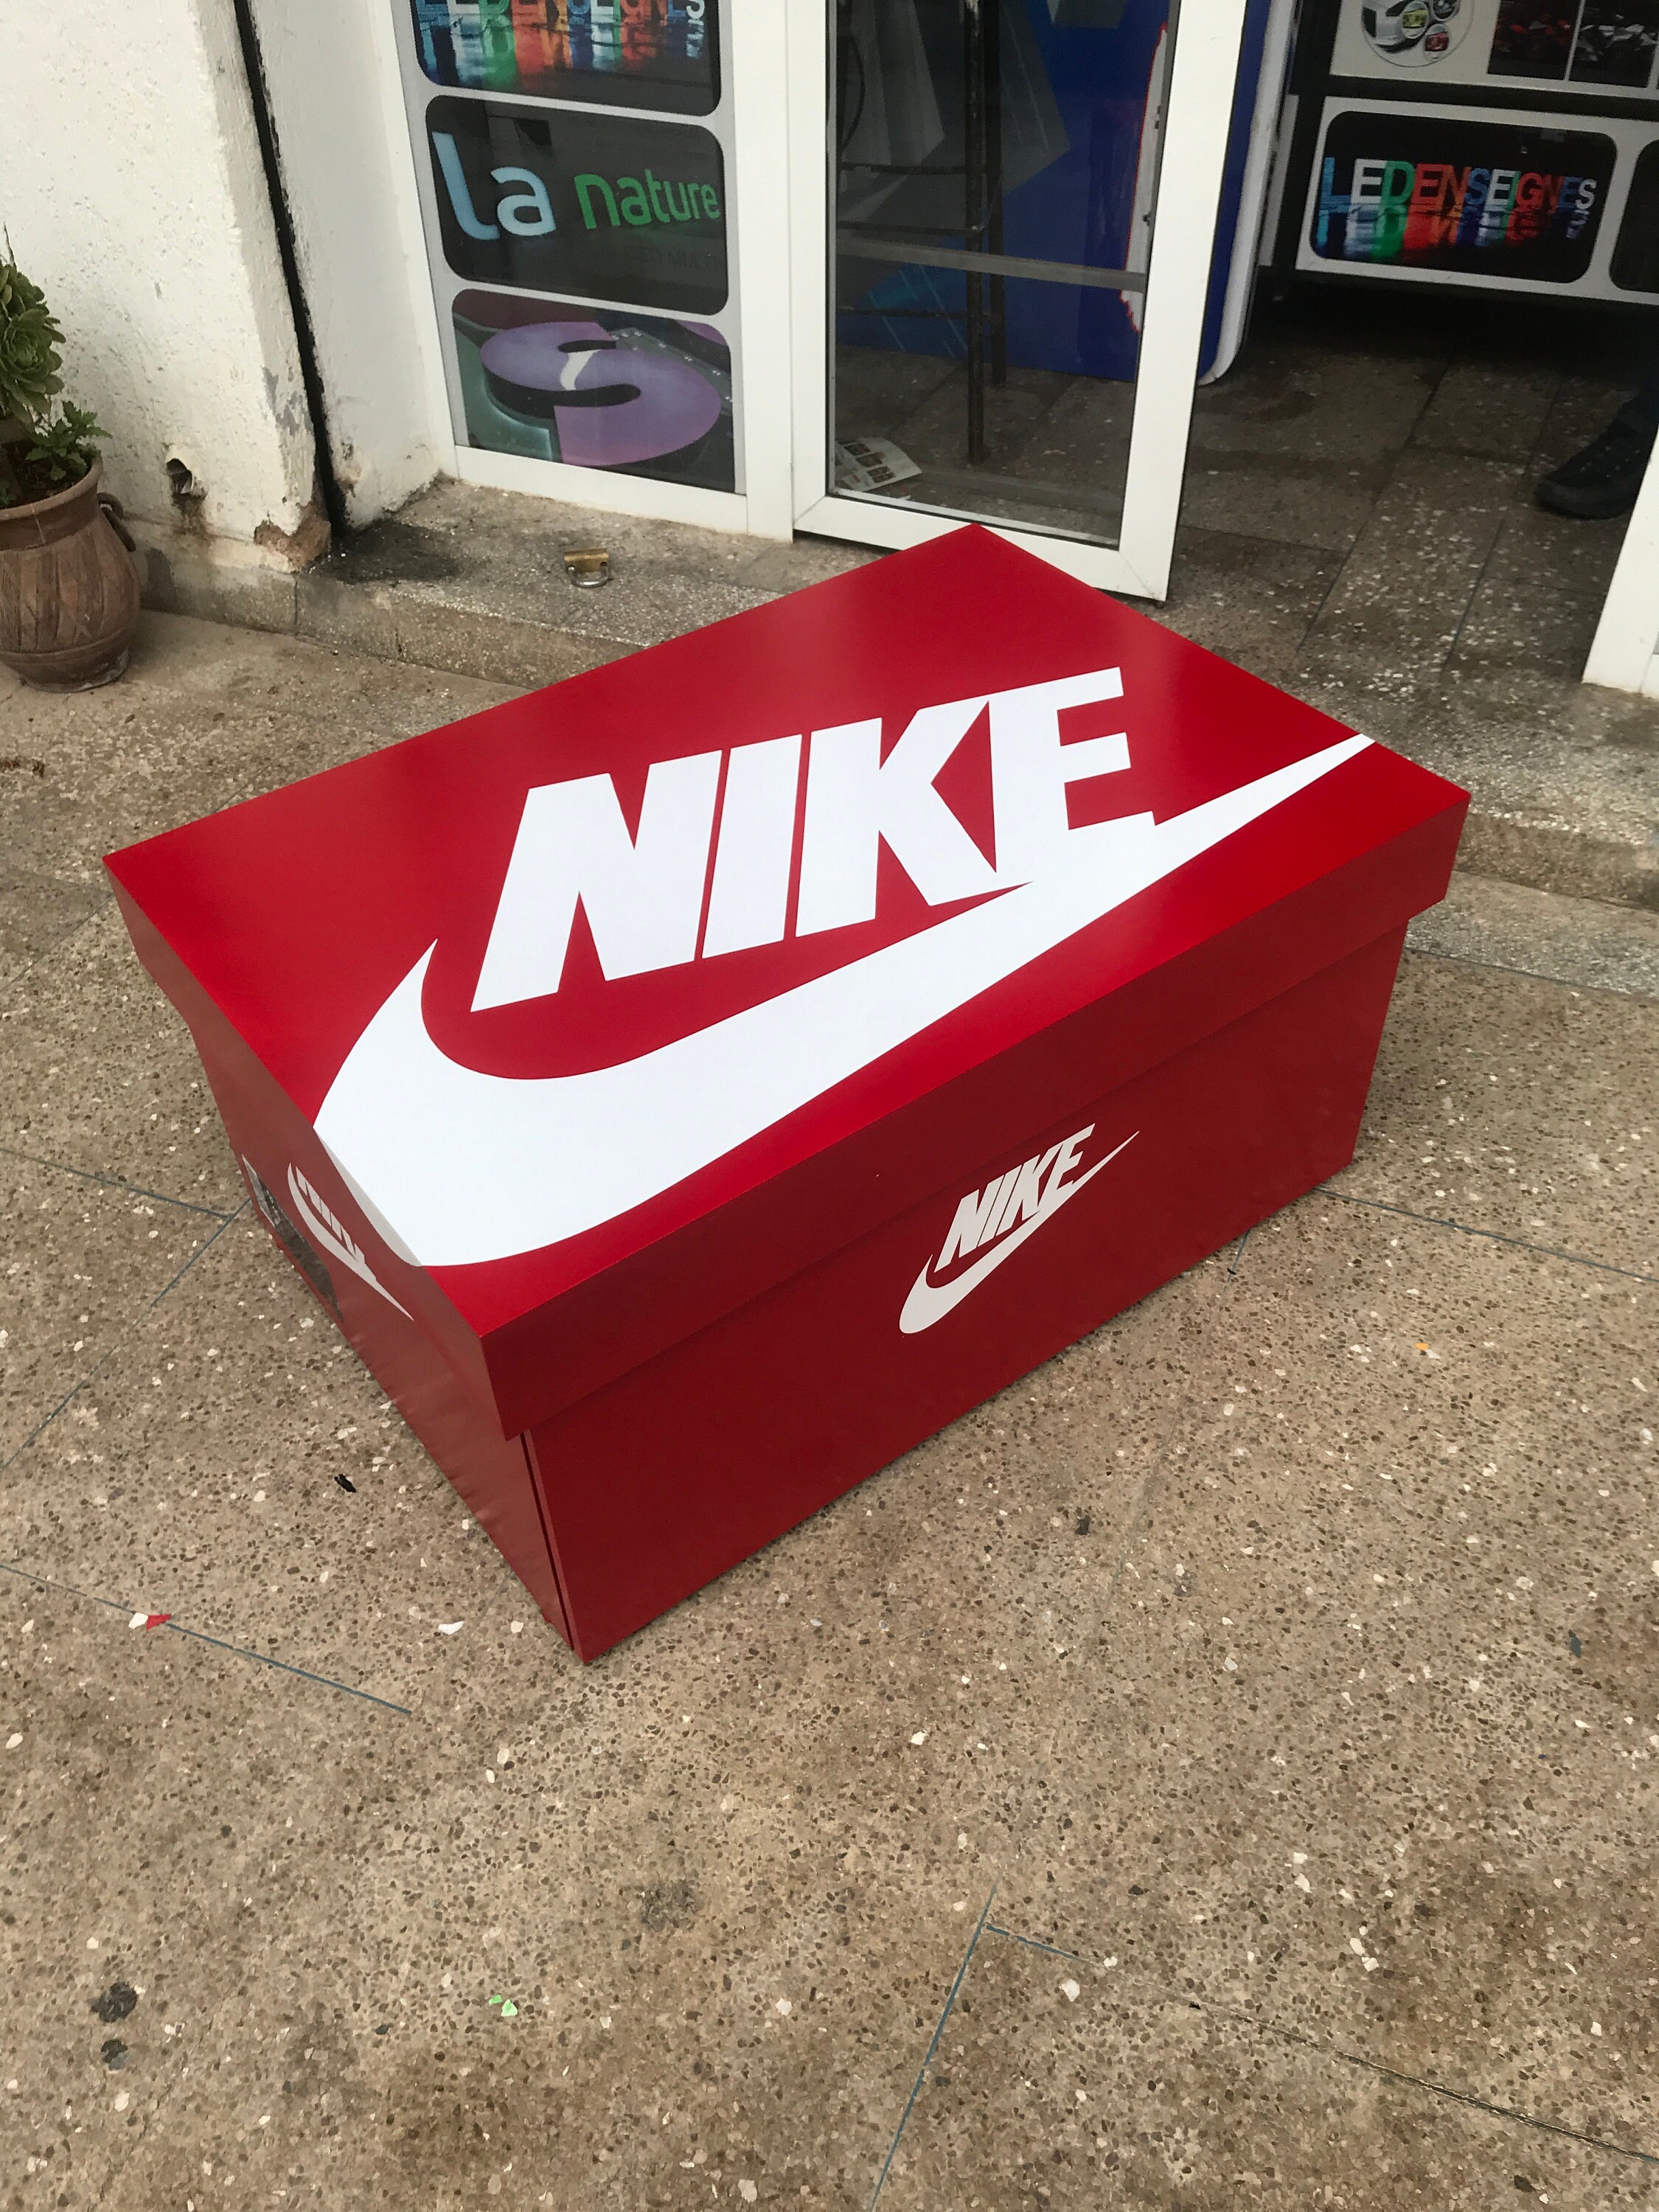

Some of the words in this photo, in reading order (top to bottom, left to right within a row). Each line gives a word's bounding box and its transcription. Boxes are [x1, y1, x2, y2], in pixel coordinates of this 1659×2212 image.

[573, 169, 721, 231] nature
[470, 667, 1154, 1012] NIKE
[933, 1122, 1096, 1273] NIKE
